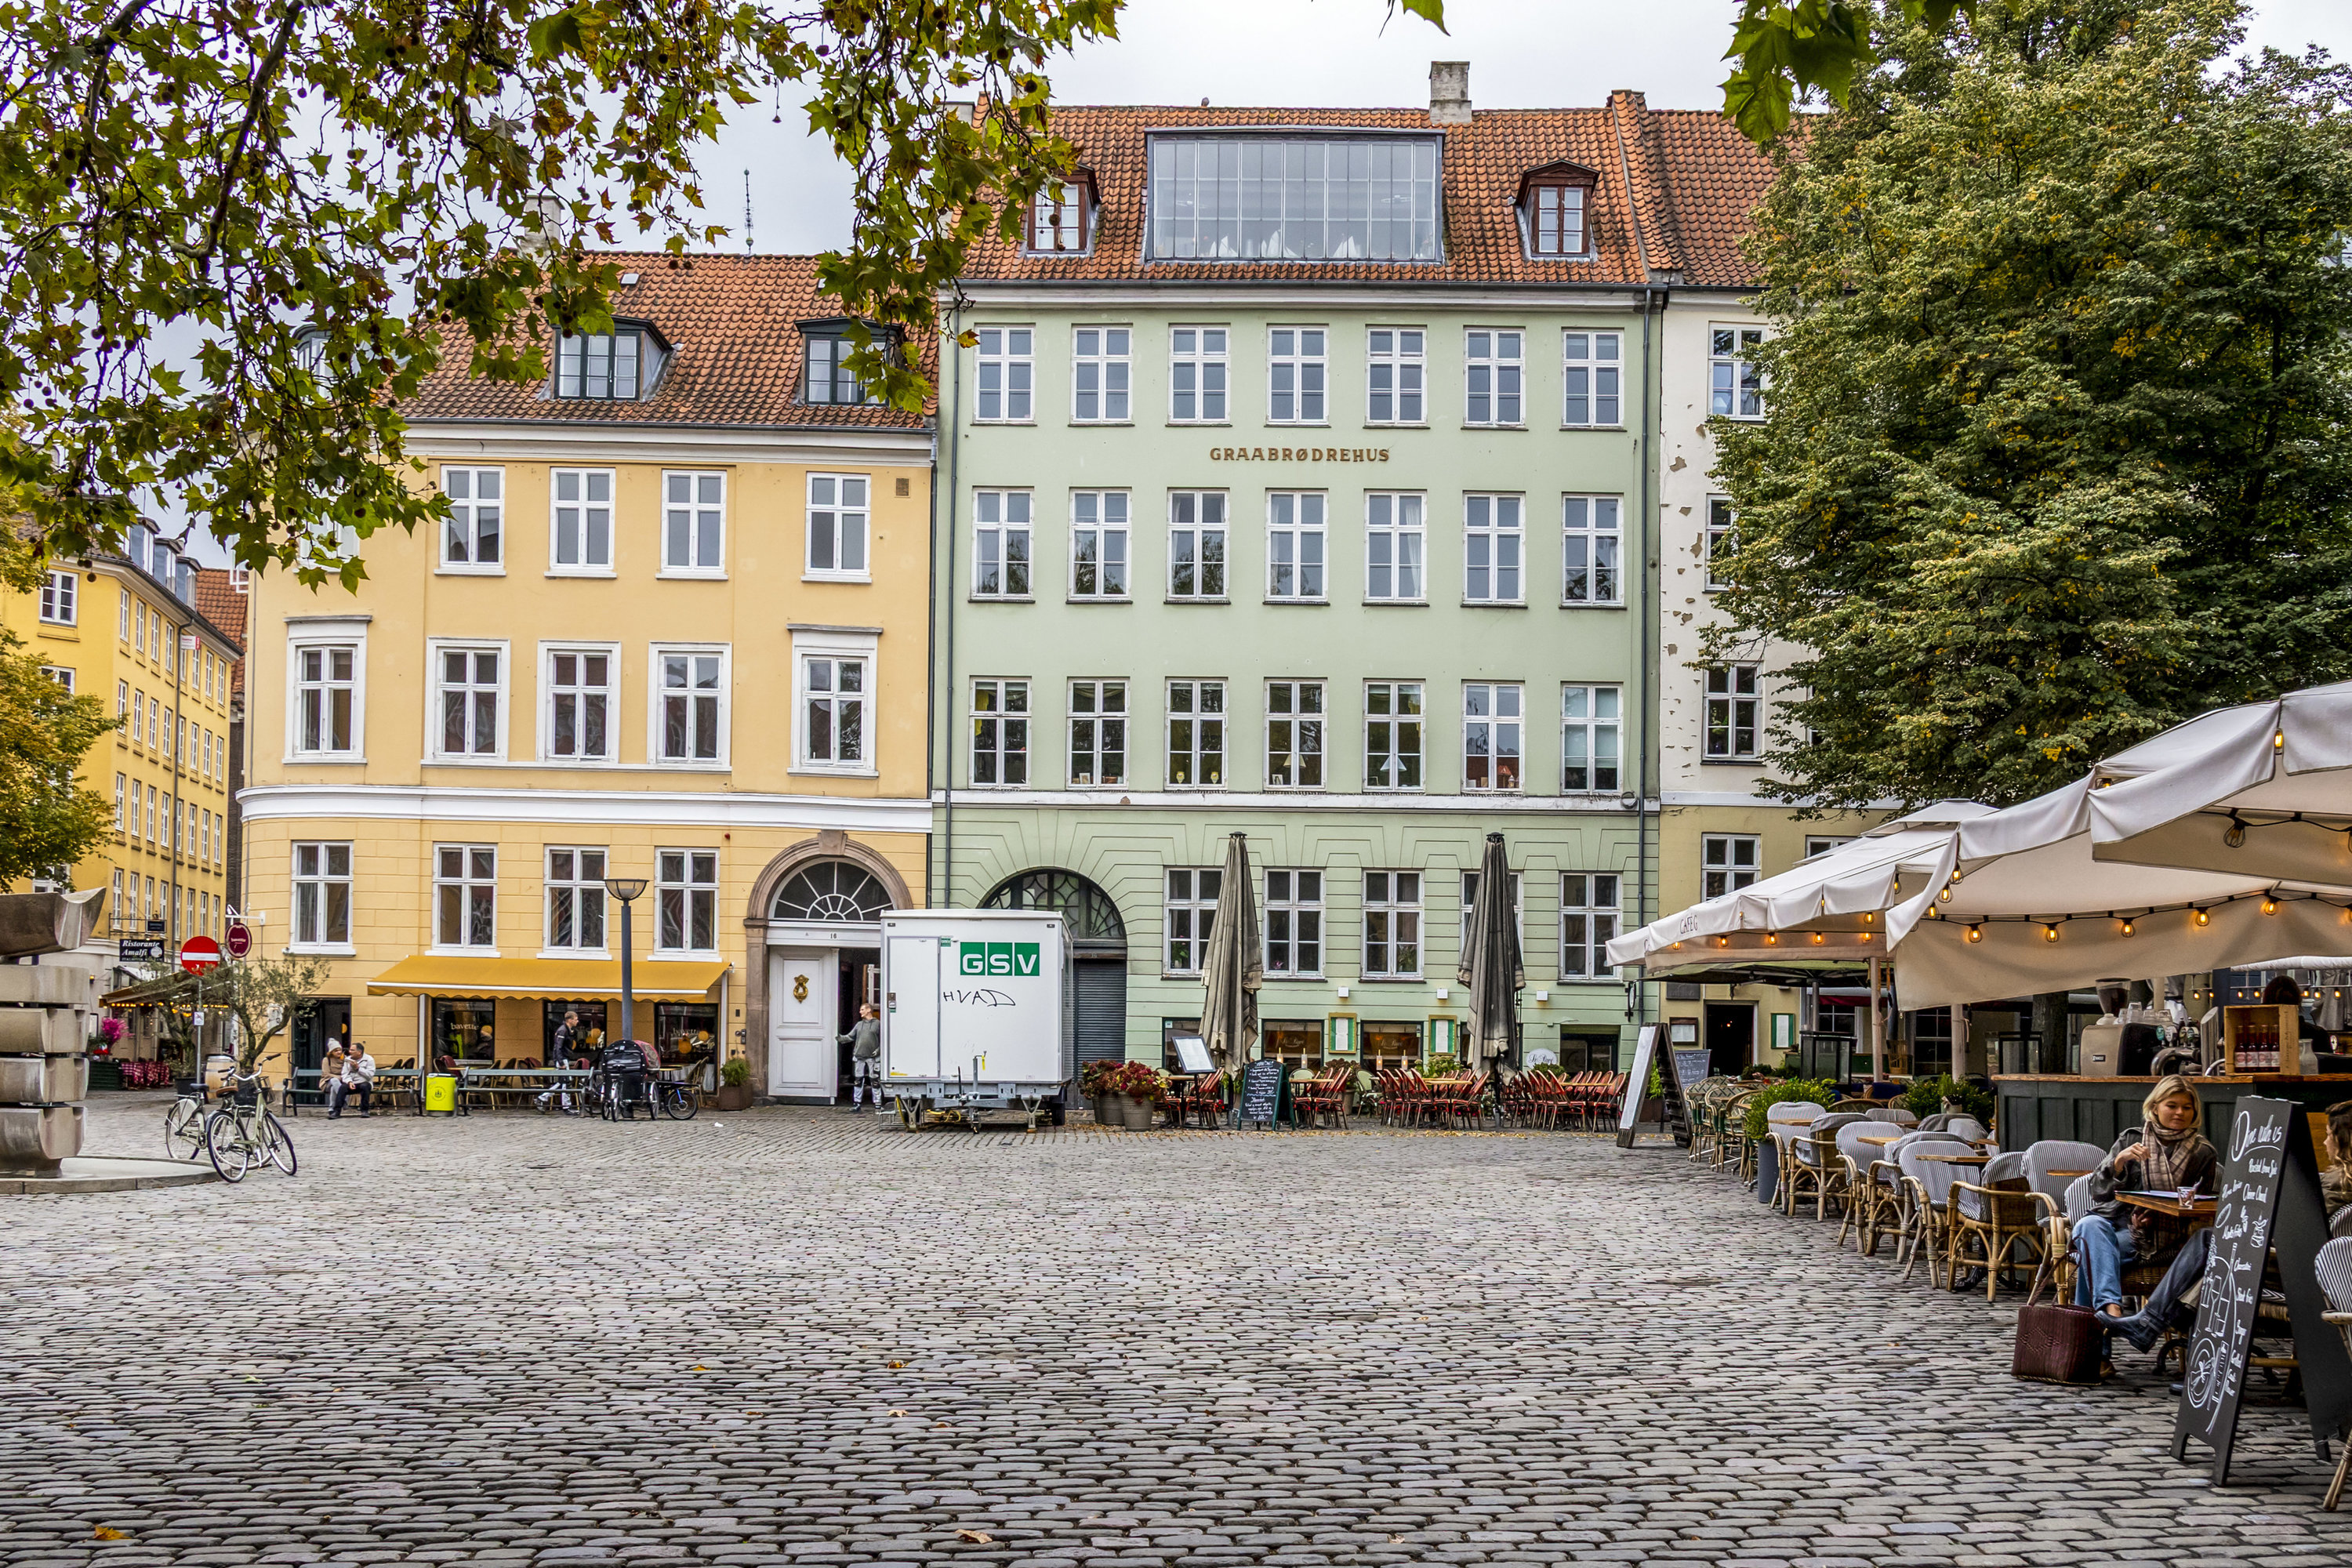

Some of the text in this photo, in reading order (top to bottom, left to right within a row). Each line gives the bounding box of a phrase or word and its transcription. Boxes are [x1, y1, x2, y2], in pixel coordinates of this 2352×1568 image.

[1210, 447, 1390, 463] GRAABRØDREHUS
[122, 949, 147, 957] Amalfi
[961, 953, 1038, 974] GSV
